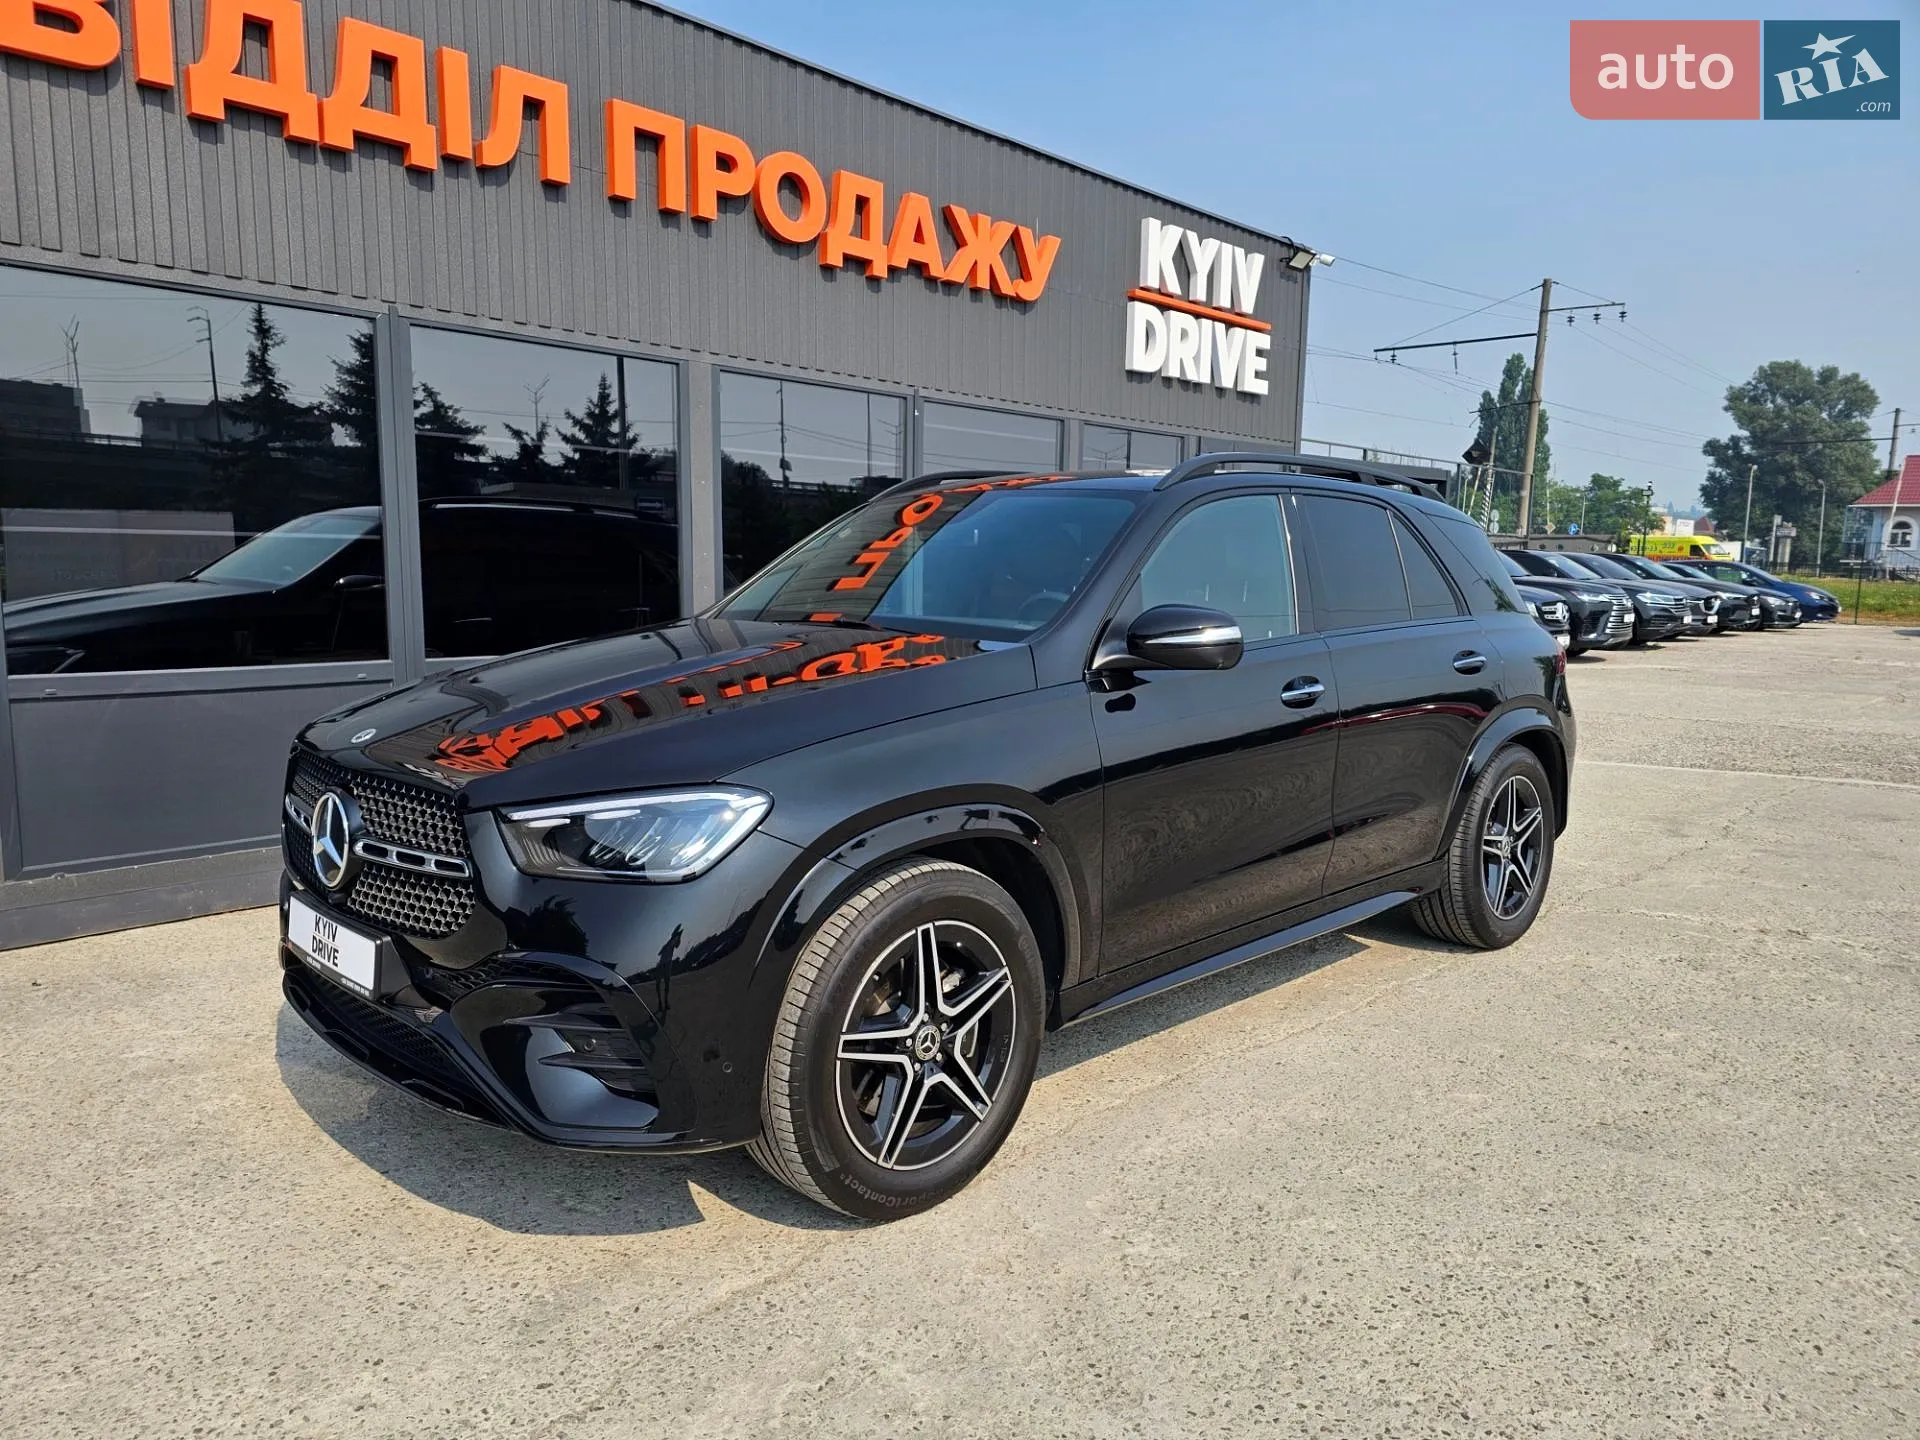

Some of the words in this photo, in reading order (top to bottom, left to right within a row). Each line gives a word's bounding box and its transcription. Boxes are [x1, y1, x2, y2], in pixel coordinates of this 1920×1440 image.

[605, 98, 1062, 302] ПРОДАЖУ
[1139, 217, 1265, 315] KYIV
[1125, 301, 1272, 396] DRIVE
[312, 934, 339, 967] DRIVE
[314, 914, 338, 943] KYIV
